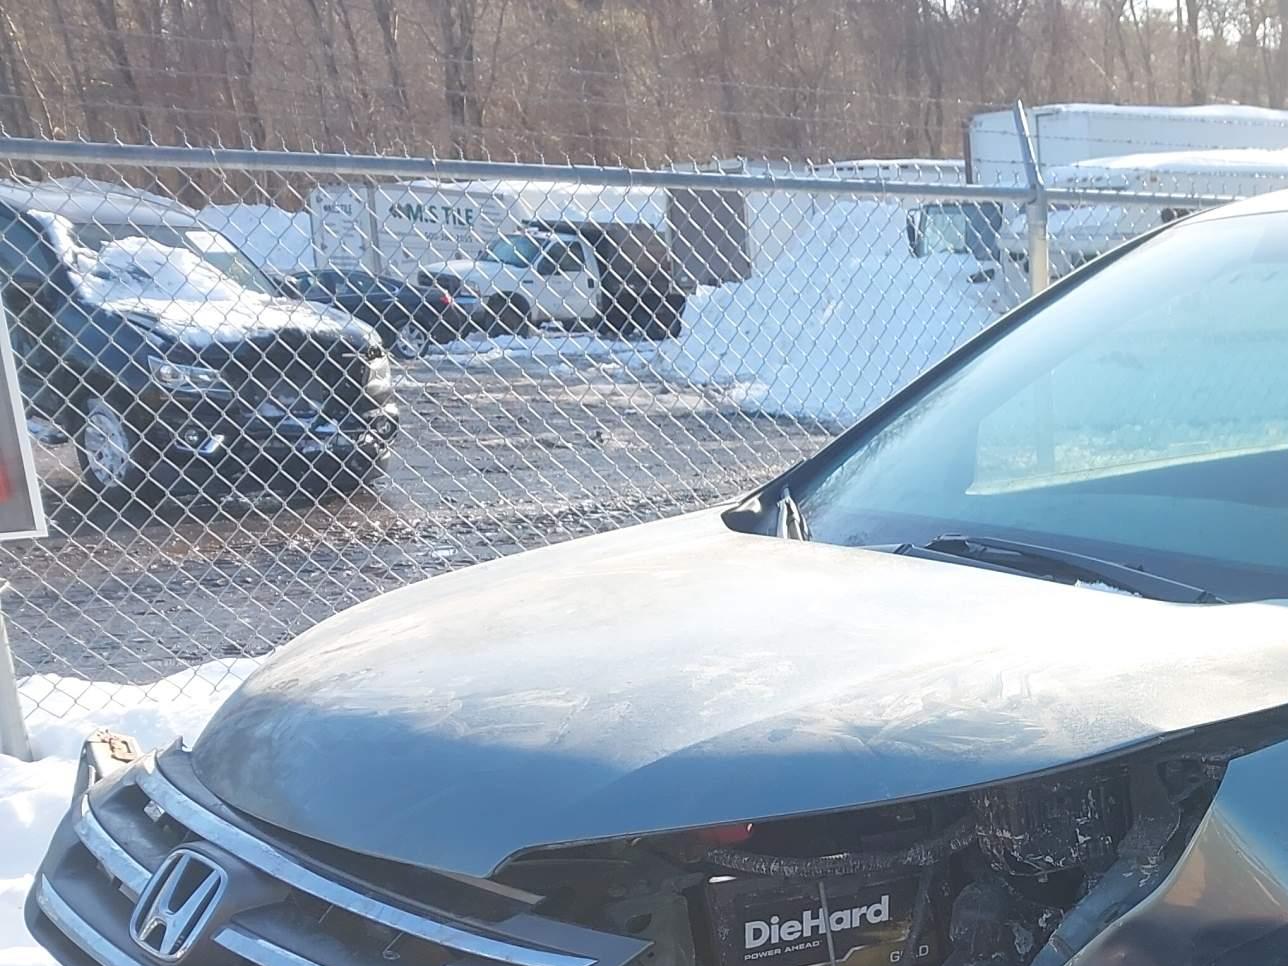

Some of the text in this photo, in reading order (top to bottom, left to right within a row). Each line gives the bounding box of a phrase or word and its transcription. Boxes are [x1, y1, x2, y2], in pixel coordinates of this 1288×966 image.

[745, 895, 890, 949] DieHard
[744, 940, 820, 961] POWER AHEAD
[890, 944, 929, 963] GD
